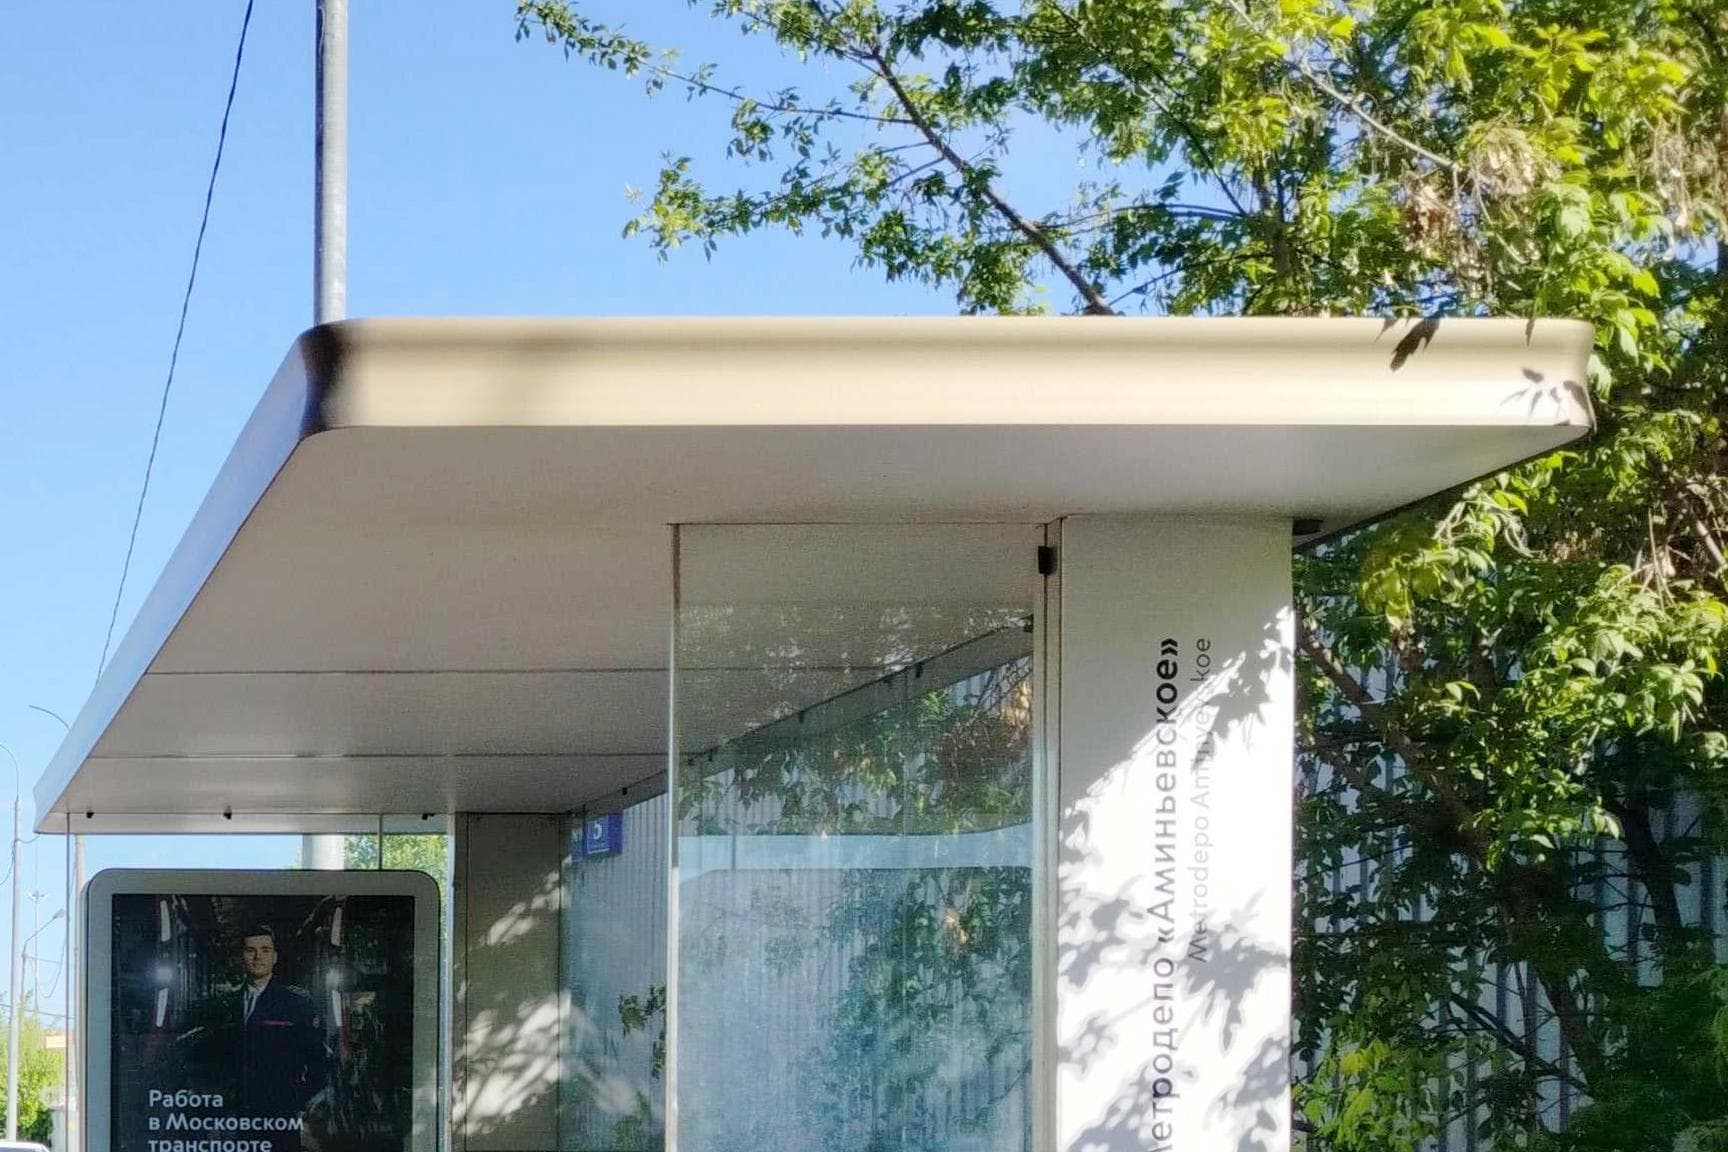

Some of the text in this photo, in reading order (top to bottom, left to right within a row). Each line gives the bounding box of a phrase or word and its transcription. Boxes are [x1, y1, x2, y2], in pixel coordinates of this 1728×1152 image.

[1146, 637, 1180, 943] «Аминьевское»
[1187, 815, 1215, 963] Metrodepo
[148, 1089, 224, 1108] Работа
[148, 1113, 305, 1131] в Московском
